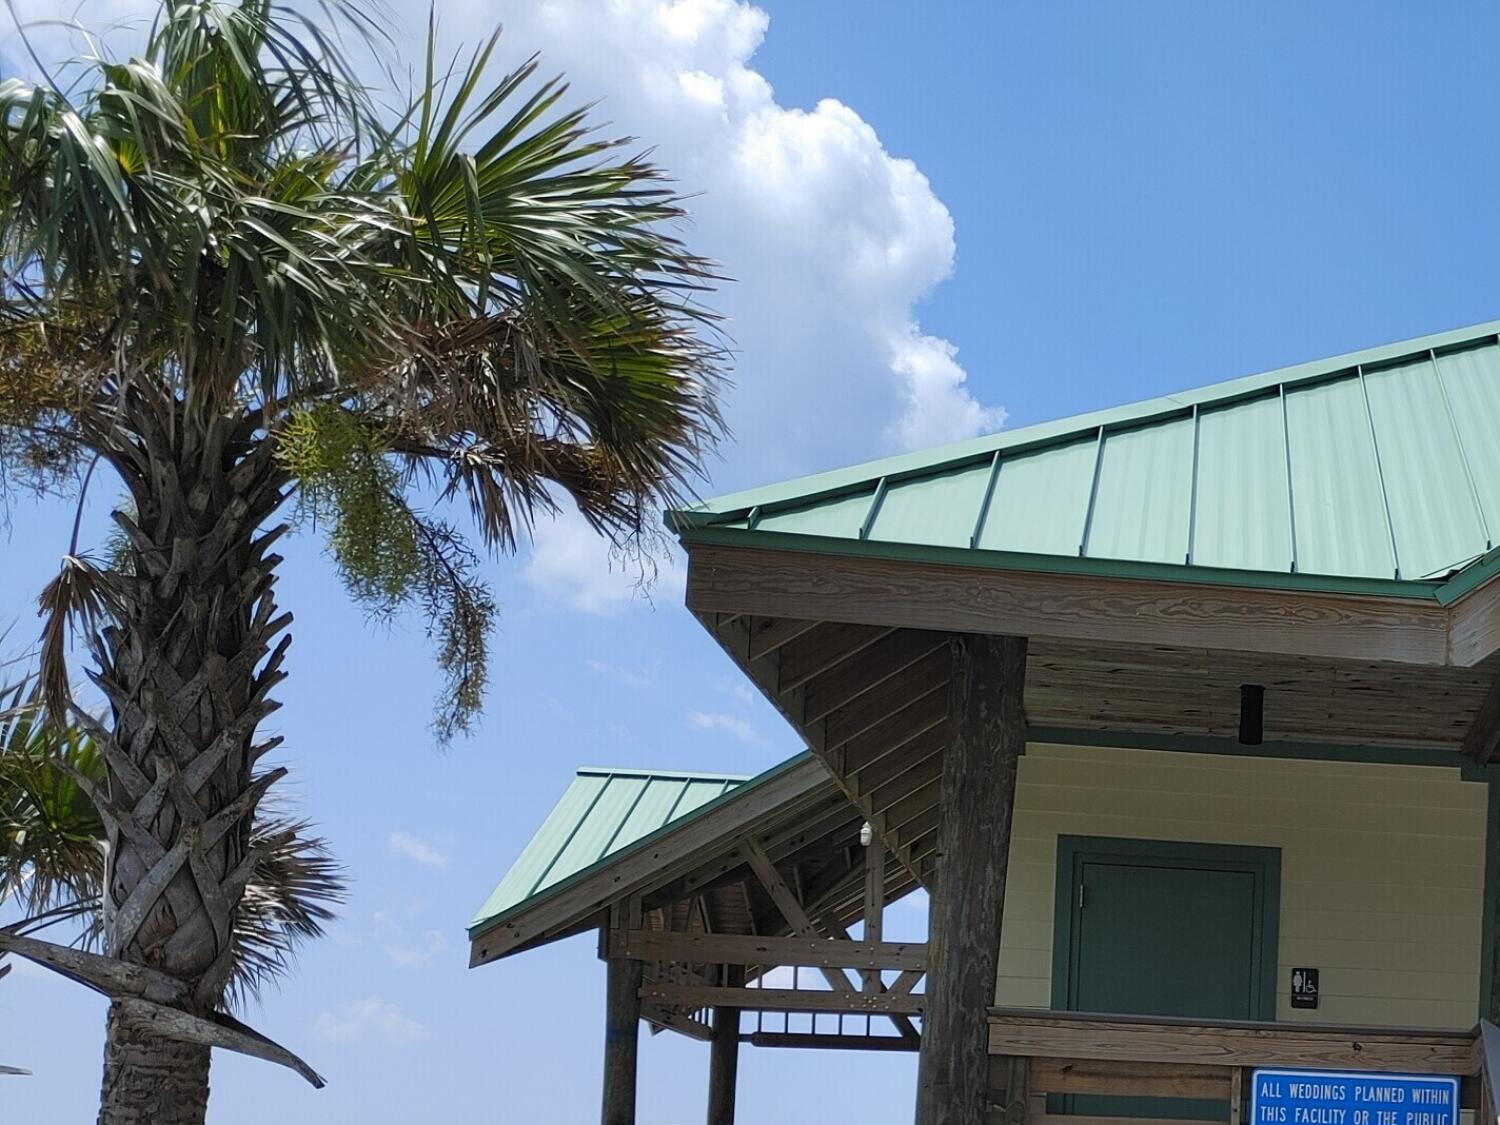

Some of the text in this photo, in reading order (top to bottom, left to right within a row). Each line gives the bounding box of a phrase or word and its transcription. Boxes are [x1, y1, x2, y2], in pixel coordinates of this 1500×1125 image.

[1261, 1082, 1449, 1104] ALL WEDDINGS PLANNED WITHIN
[1261, 1106, 1286, 1122] THIS
[1295, 1108, 1346, 1125] FACILITY
[1354, 1111, 1368, 1125] OR
[1377, 1111, 1397, 1125] THE
